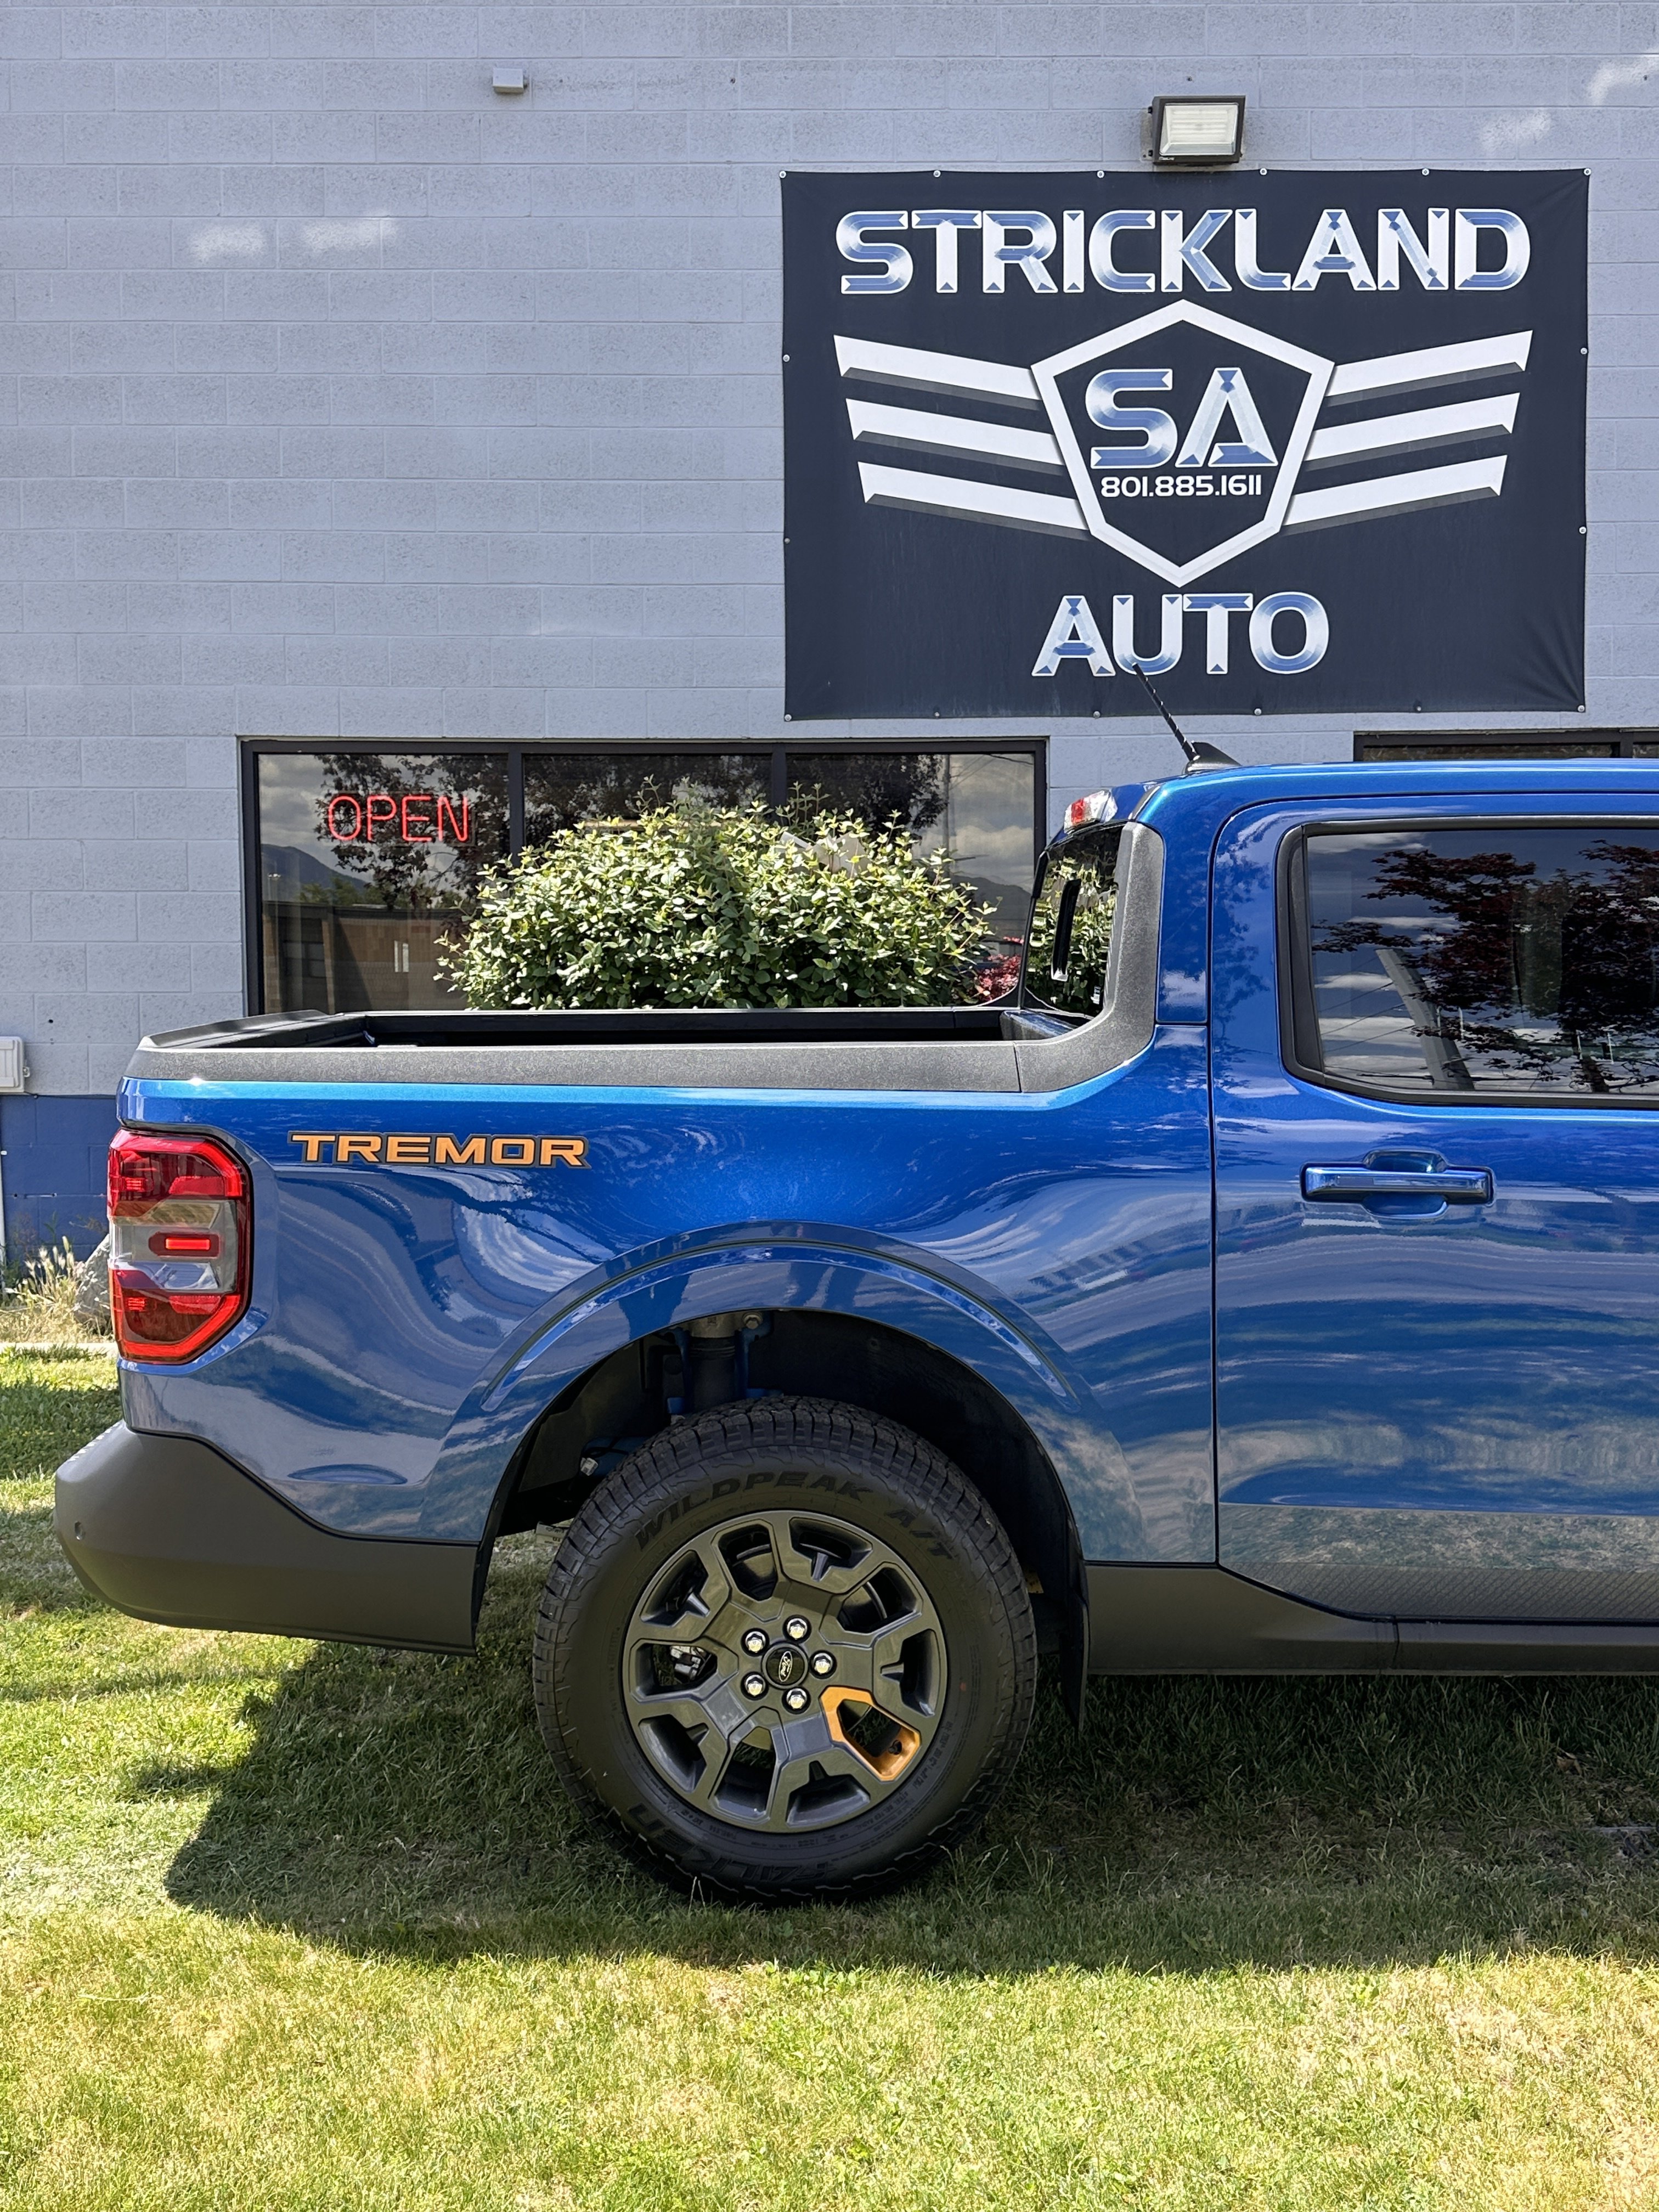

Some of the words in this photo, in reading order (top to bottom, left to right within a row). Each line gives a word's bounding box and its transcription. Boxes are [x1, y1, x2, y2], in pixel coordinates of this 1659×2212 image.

[836, 208, 1531, 294] STRICKLAND
[1085, 368, 1279, 469] SA
[1101, 475, 1262, 498] 801.885.1611
[1032, 592, 1329, 678] AUTO
[328, 795, 468, 841] OPEN
[289, 1131, 591, 1169] TREMOR
[637, 1471, 873, 1549] WILDPEAK
